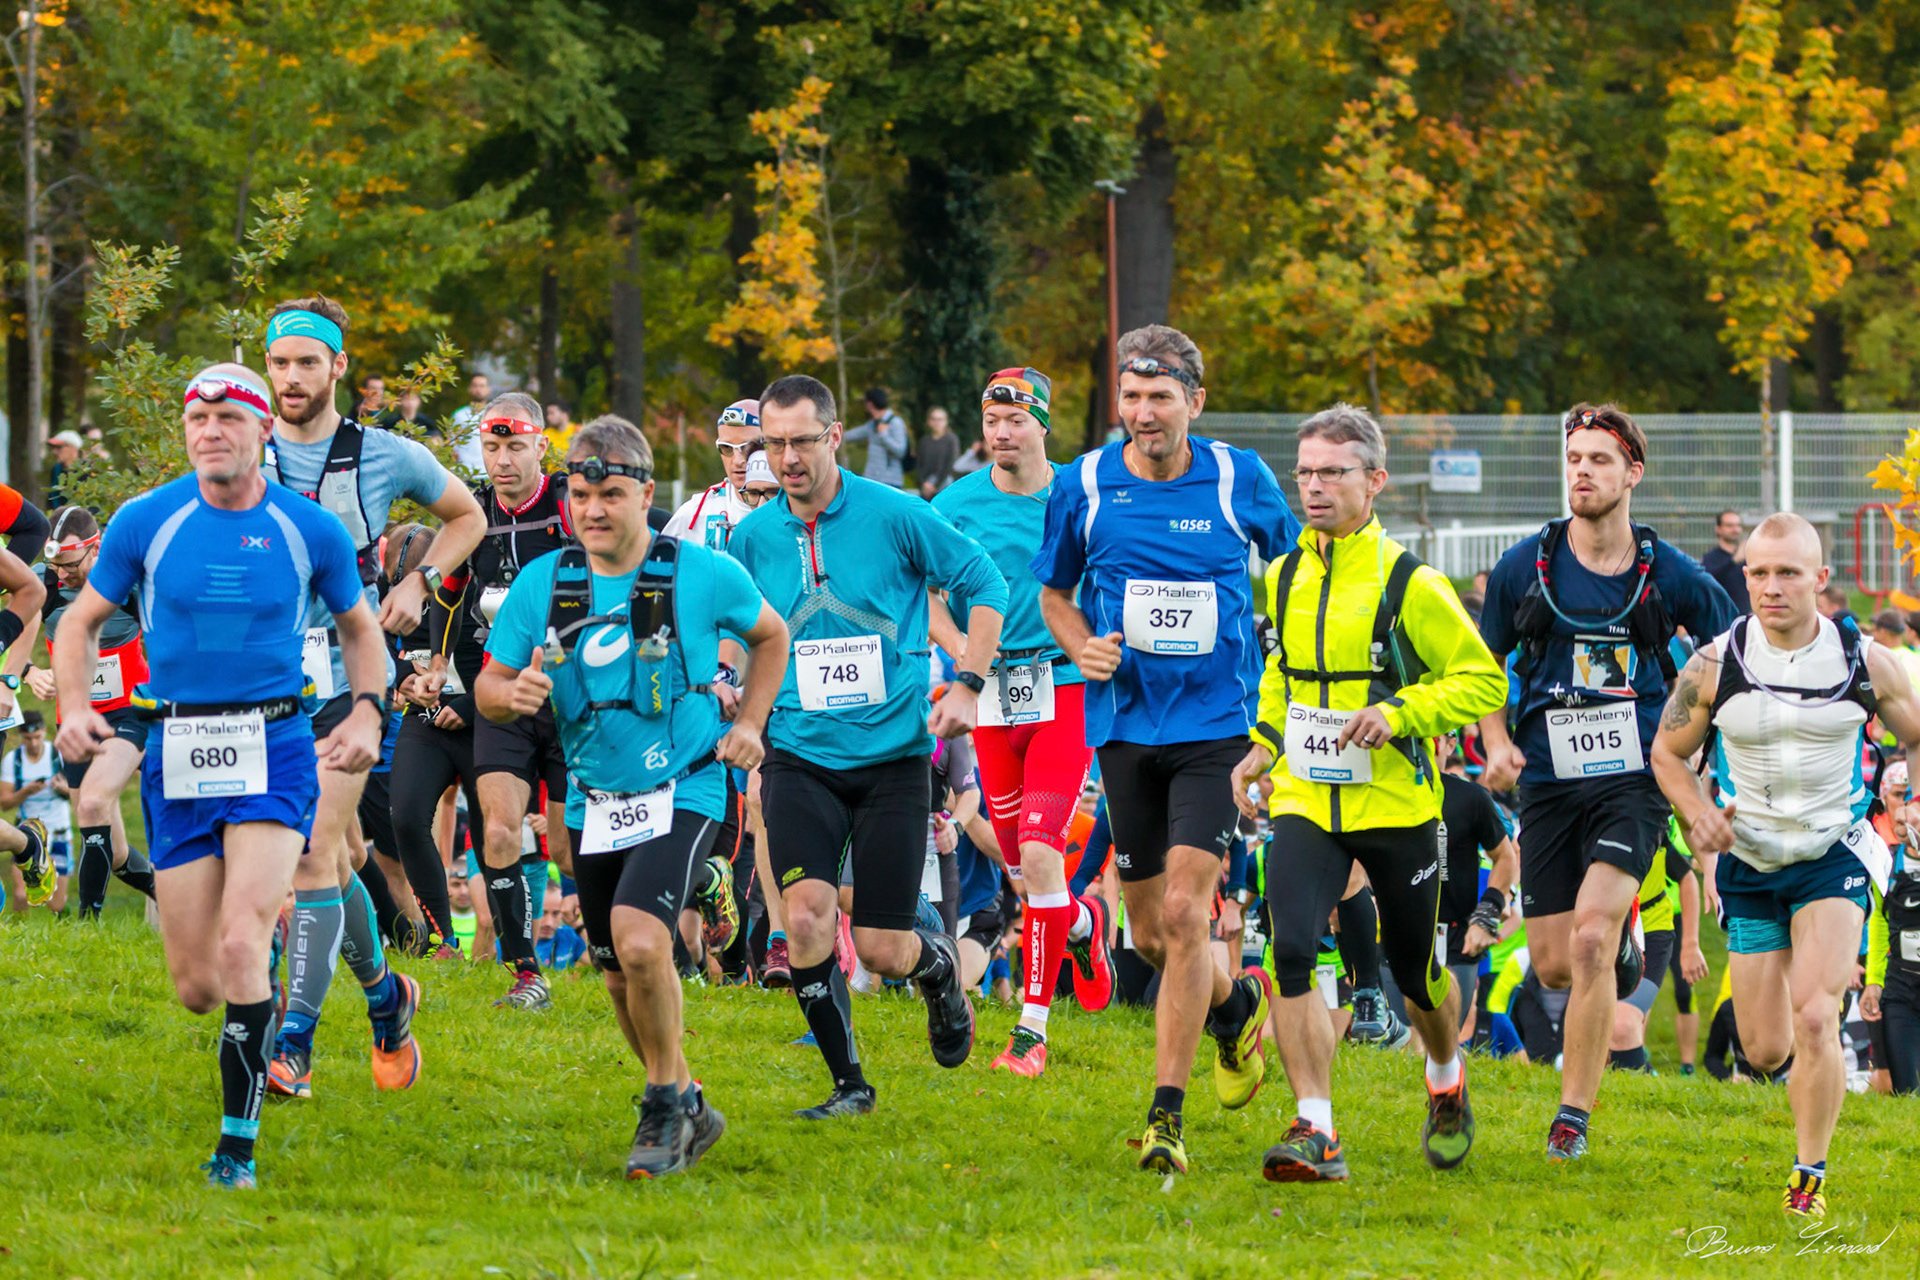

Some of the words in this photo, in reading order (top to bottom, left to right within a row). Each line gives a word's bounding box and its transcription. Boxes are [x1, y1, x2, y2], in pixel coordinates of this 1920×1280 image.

[1180, 519, 1212, 531] ases
[1157, 585, 1214, 602] Kalenji
[1149, 608, 1193, 629] 357
[823, 639, 878, 655] Kalenji
[1155, 642, 1197, 650] DECATHLON
[819, 663, 859, 685] 748
[828, 694, 867, 705] DECATHLON
[998, 685, 1033, 703] 99
[1576, 707, 1633, 724] Kalenji
[196, 720, 261, 736] Kalenji
[1304, 734, 1340, 757] 441
[1568, 730, 1622, 753] 1015
[190, 746, 238, 769] 680
[1311, 768, 1351, 778] DECATHLON
[1584, 761, 1625, 773] DECATHLON
[609, 803, 649, 831] 356
[521, 875, 533, 939] BOOSTER
[291, 909, 317, 993] Kalenji
